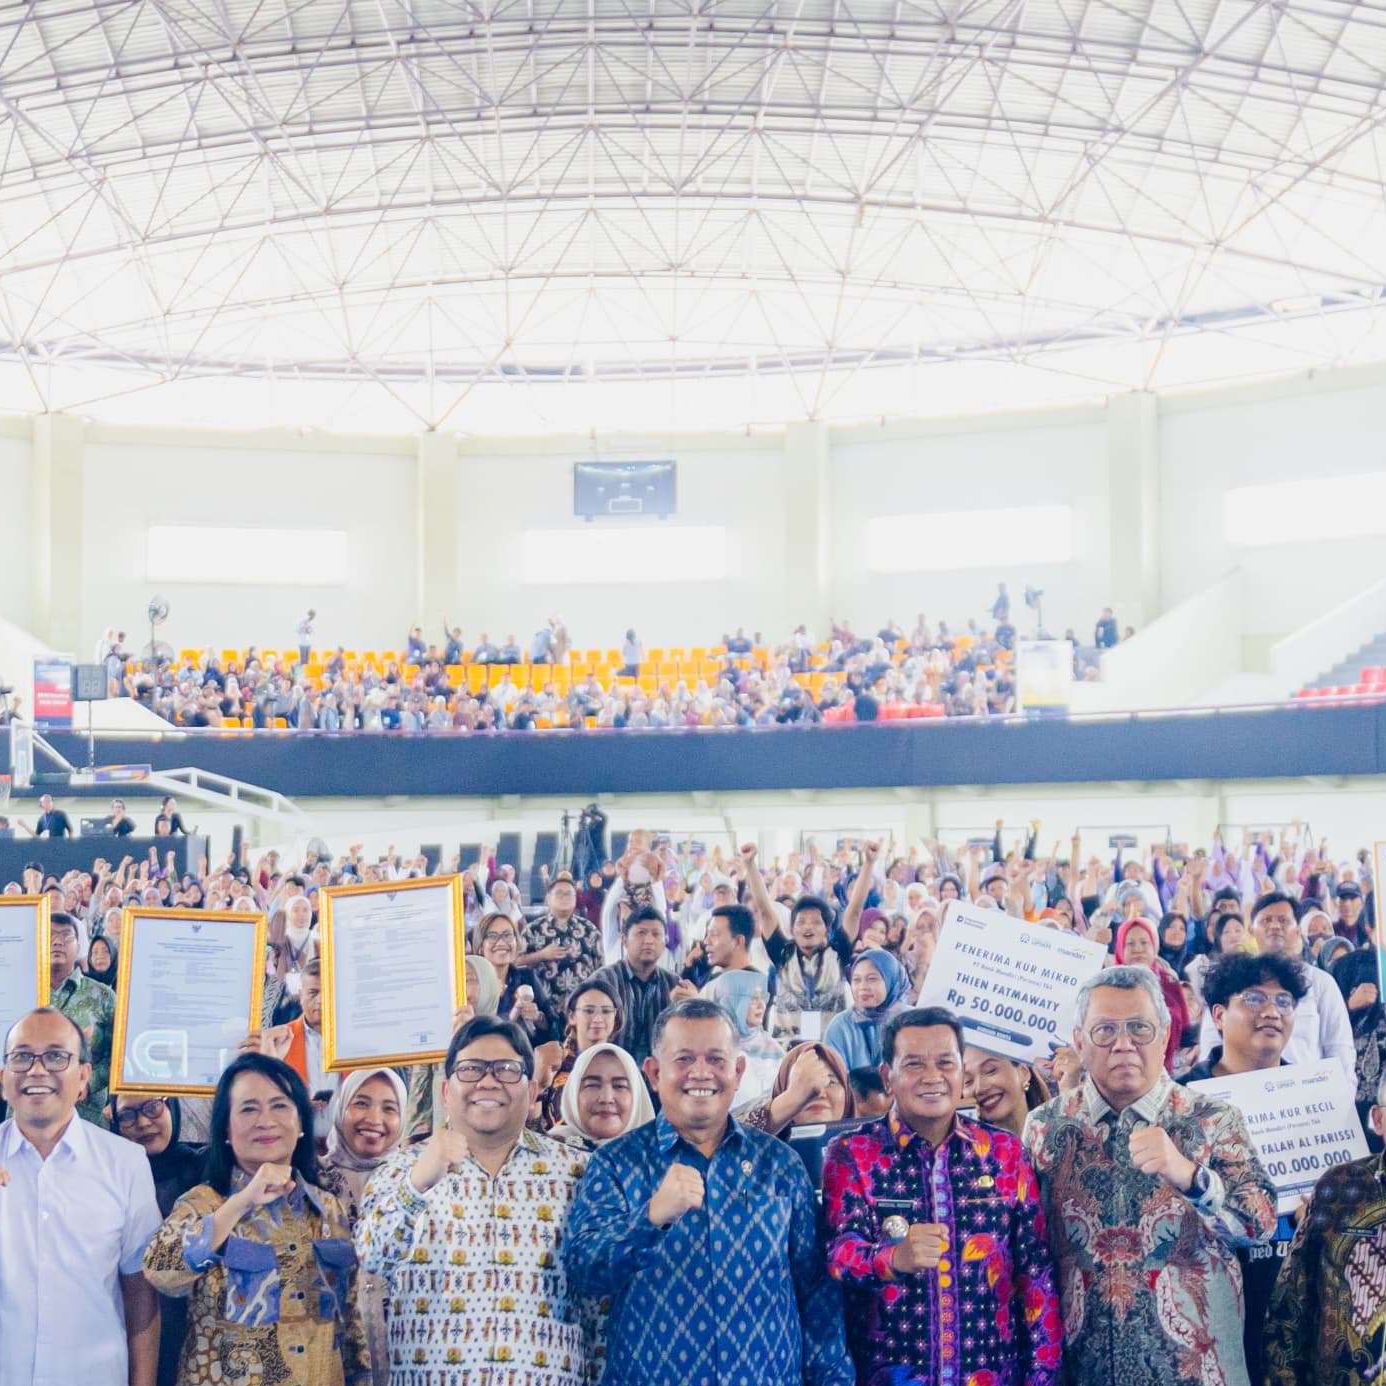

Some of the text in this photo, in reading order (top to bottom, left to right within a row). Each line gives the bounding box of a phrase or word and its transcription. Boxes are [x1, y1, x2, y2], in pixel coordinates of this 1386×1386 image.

[955, 942, 1078, 986] PENERIMA KUR MIKRO
[981, 963, 995, 973] Bank
[996, 968, 1016, 979] Mandiri
[956, 972, 1060, 1012] THIEN FATMAWATY
[947, 988, 1057, 1033] Rp 50.000.000
[1302, 1076, 1328, 1085] mandiri
[1243, 1101, 1336, 1126] ERIMA KUR KECIL
[1261, 1129, 1356, 1155] FALAH AL FARISSI
[1265, 1149, 1352, 1177] 00.000.000
